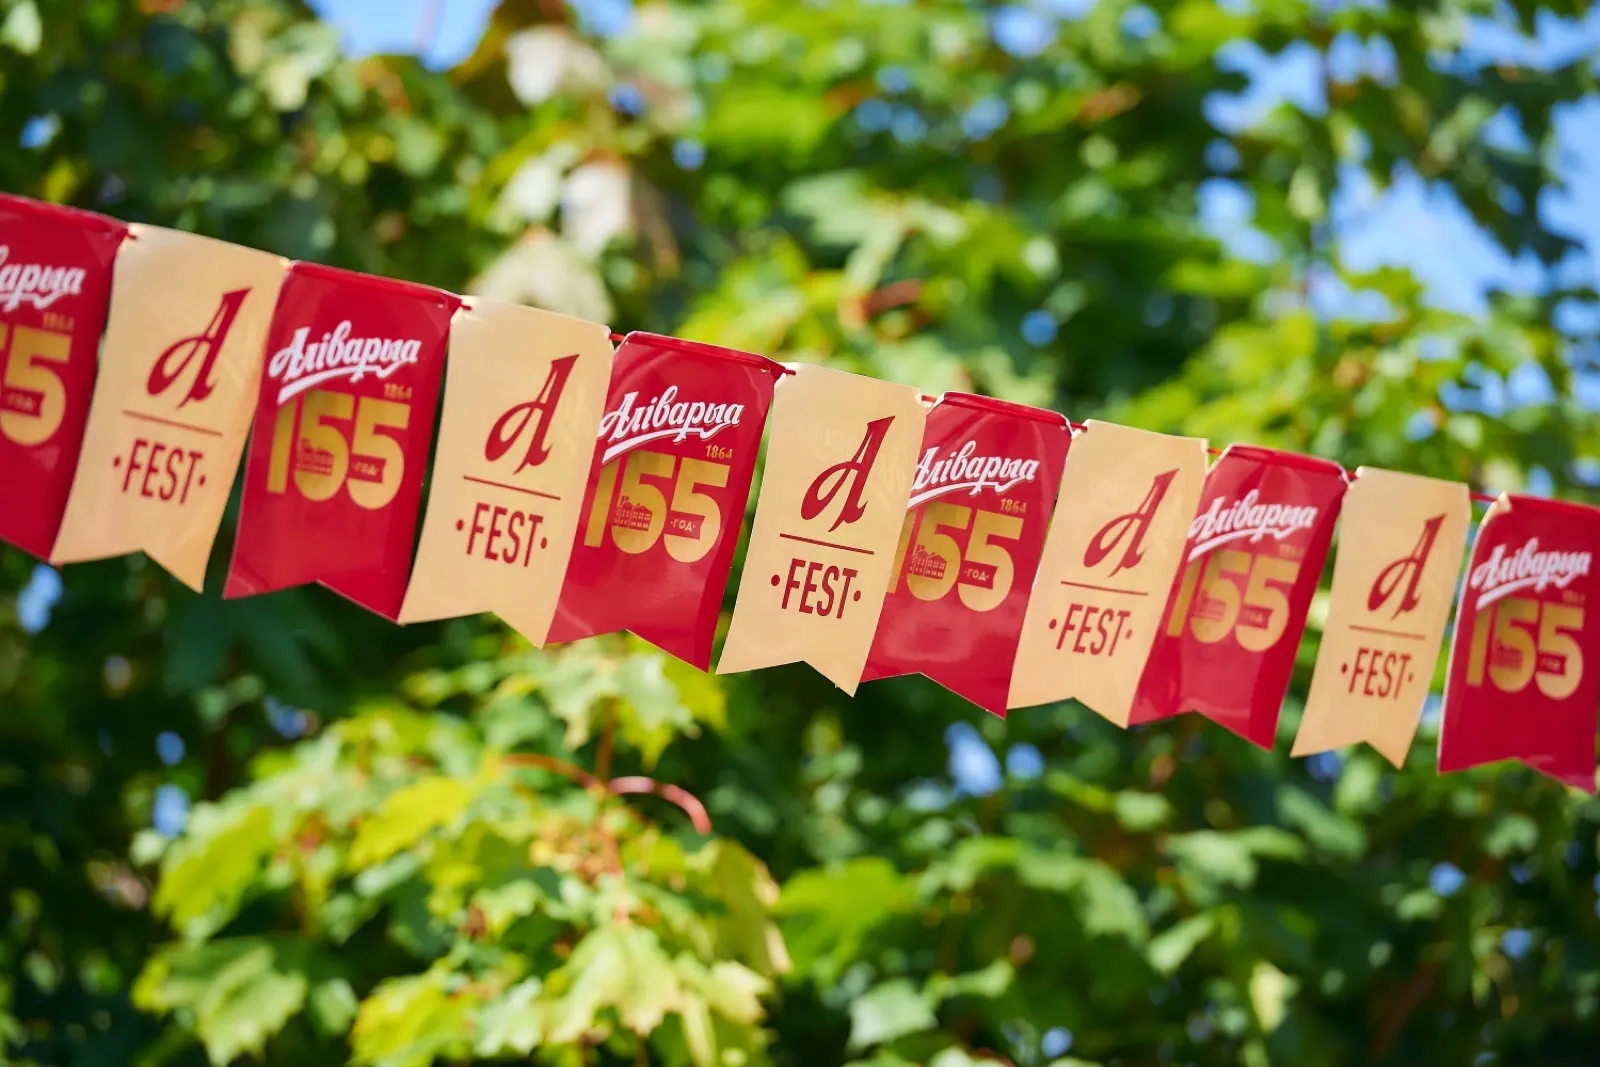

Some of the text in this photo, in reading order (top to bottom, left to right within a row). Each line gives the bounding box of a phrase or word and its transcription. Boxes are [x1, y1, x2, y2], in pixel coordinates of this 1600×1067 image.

[0, 244, 87, 313] арыя
[0, 320, 72, 446] 5
[266, 388, 411, 510] 155
[705, 444, 733, 460] 1864
[583, 449, 731, 563] 155
[1000, 497, 1027, 514] 1864
[1166, 551, 1300, 652] 155
[1466, 596, 1585, 700] 155
